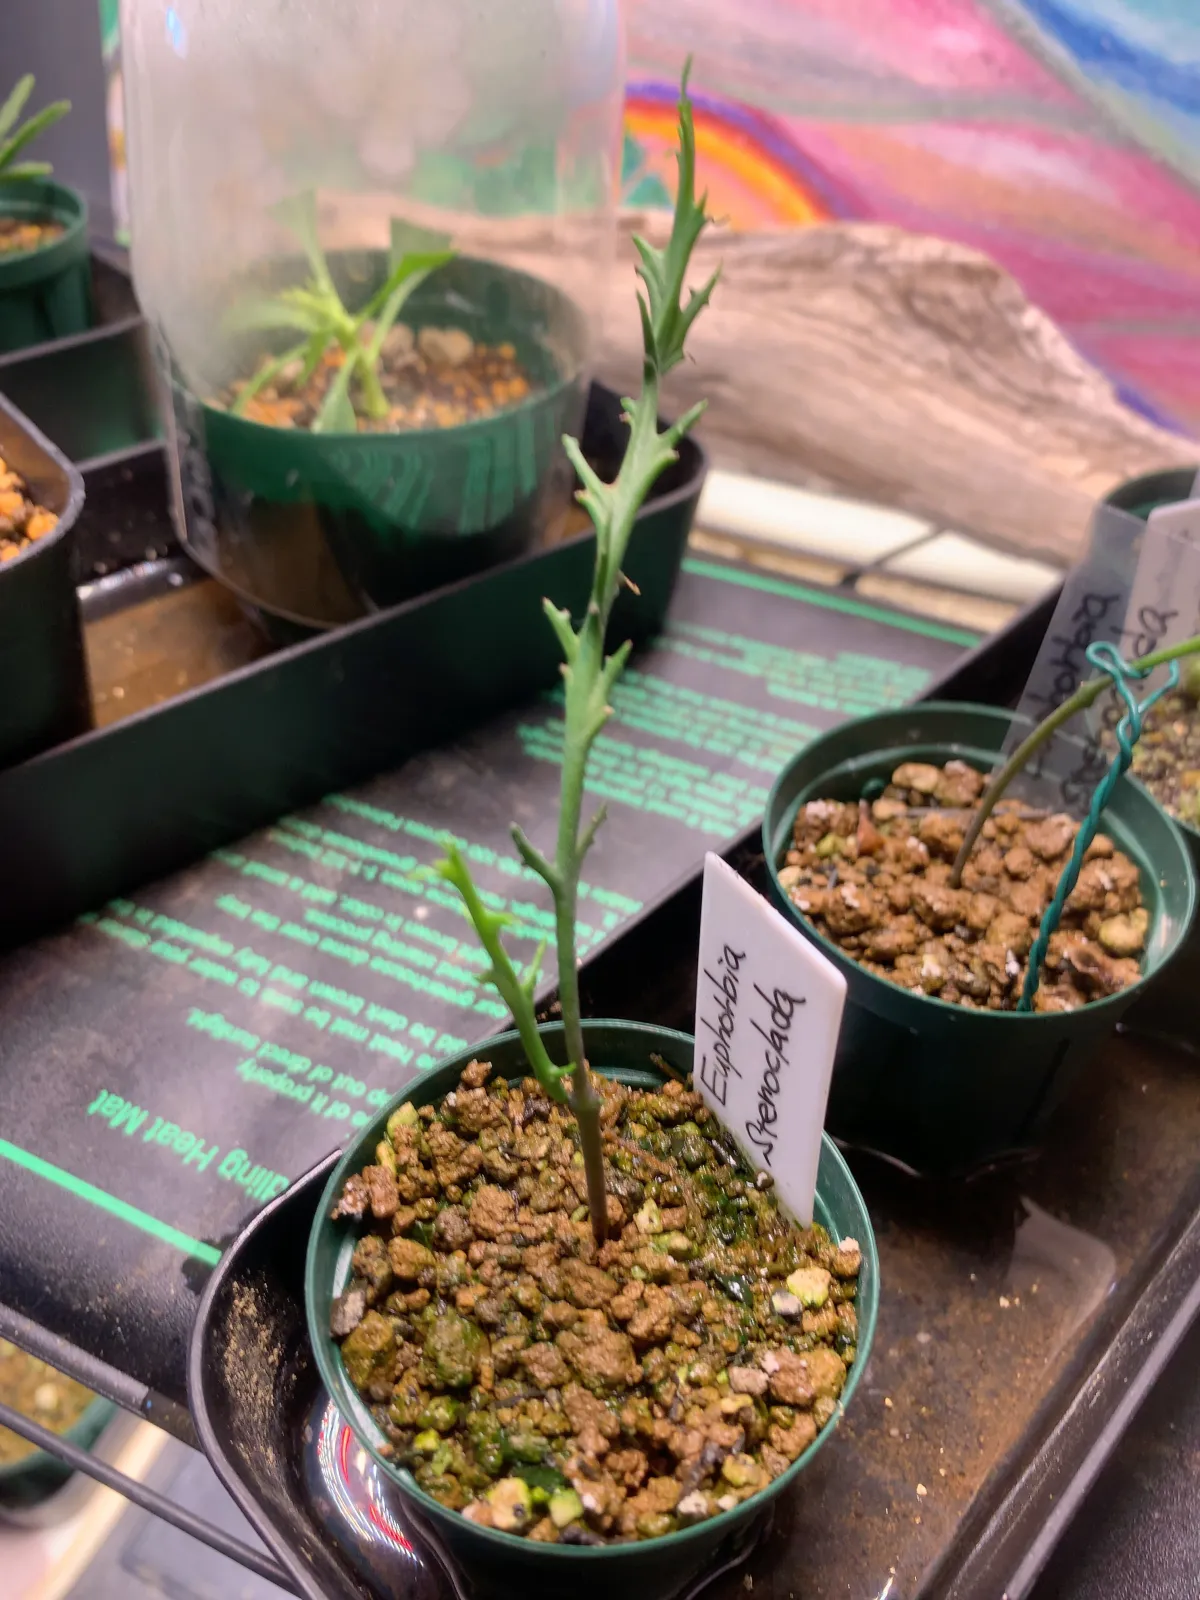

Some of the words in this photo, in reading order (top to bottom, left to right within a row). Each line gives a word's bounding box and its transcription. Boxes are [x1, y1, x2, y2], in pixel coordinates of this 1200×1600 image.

[700, 944, 748, 1108] Euphorbia
[252, 1042, 311, 1072] direct
[308, 1063, 333, 1082] of
[331, 1074, 366, 1096] out
[88, 1090, 149, 1135] Mat
[310, 1094, 328, 1114] it
[324, 1101, 350, 1118] of
[144, 1118, 219, 1171] Heat
